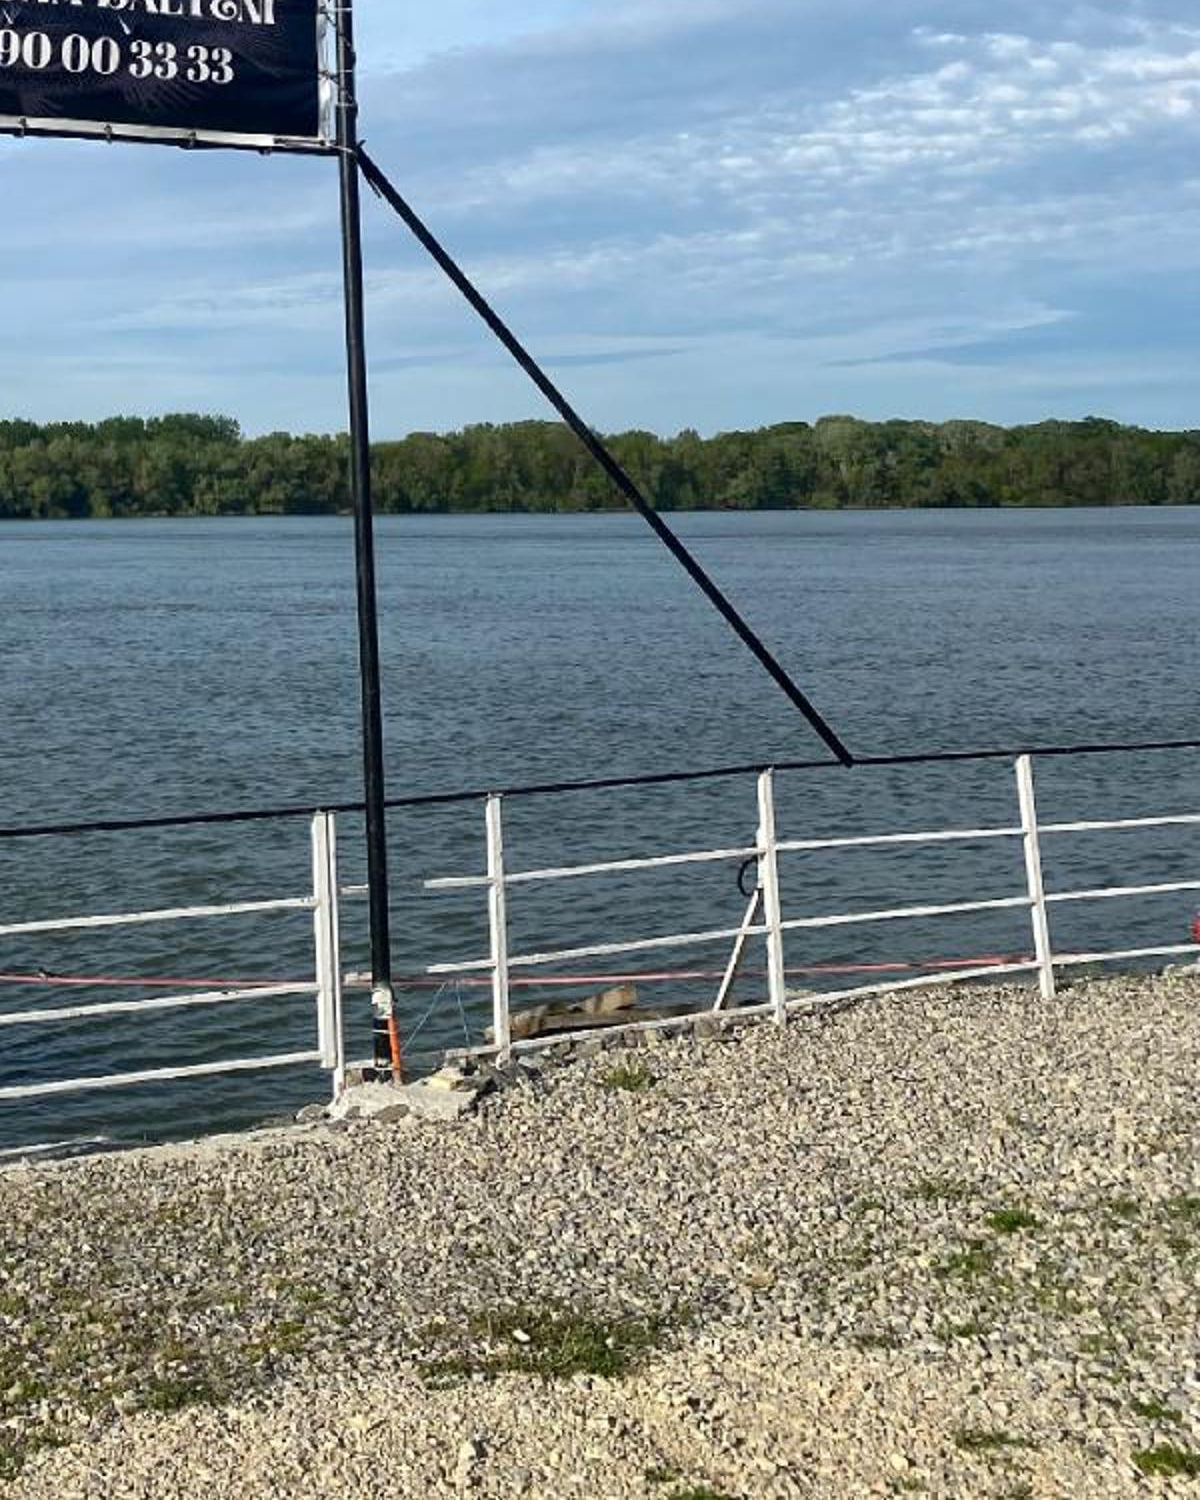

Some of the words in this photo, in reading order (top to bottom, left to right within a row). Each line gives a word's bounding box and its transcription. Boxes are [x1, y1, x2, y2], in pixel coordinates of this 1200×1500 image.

[61, 33, 121, 75] 00
[128, 39, 179, 79] 33
[186, 45, 234, 84] 33
